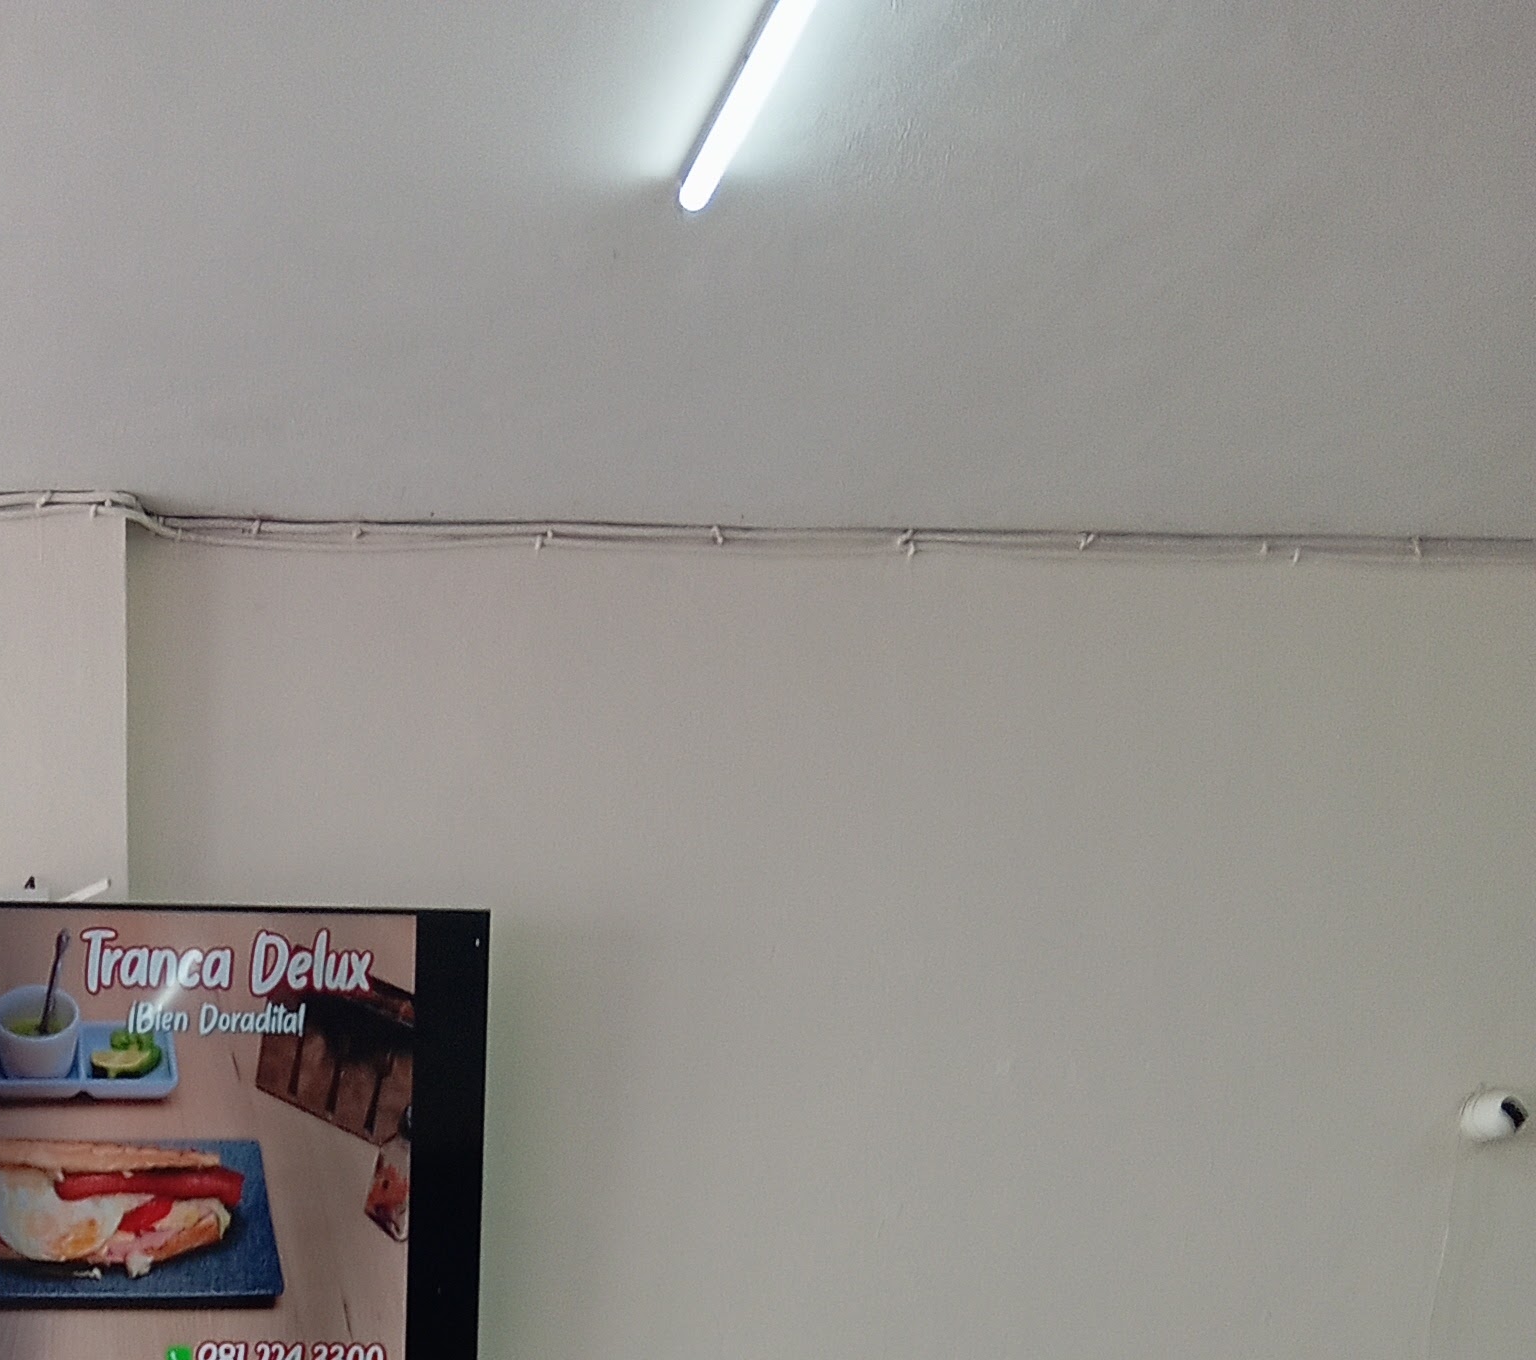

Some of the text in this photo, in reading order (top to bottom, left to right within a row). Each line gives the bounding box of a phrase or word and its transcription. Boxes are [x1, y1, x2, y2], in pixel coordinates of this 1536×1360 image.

[81, 928, 372, 996] Tranca Delux
[199, 1002, 306, 1036] Doradita!
